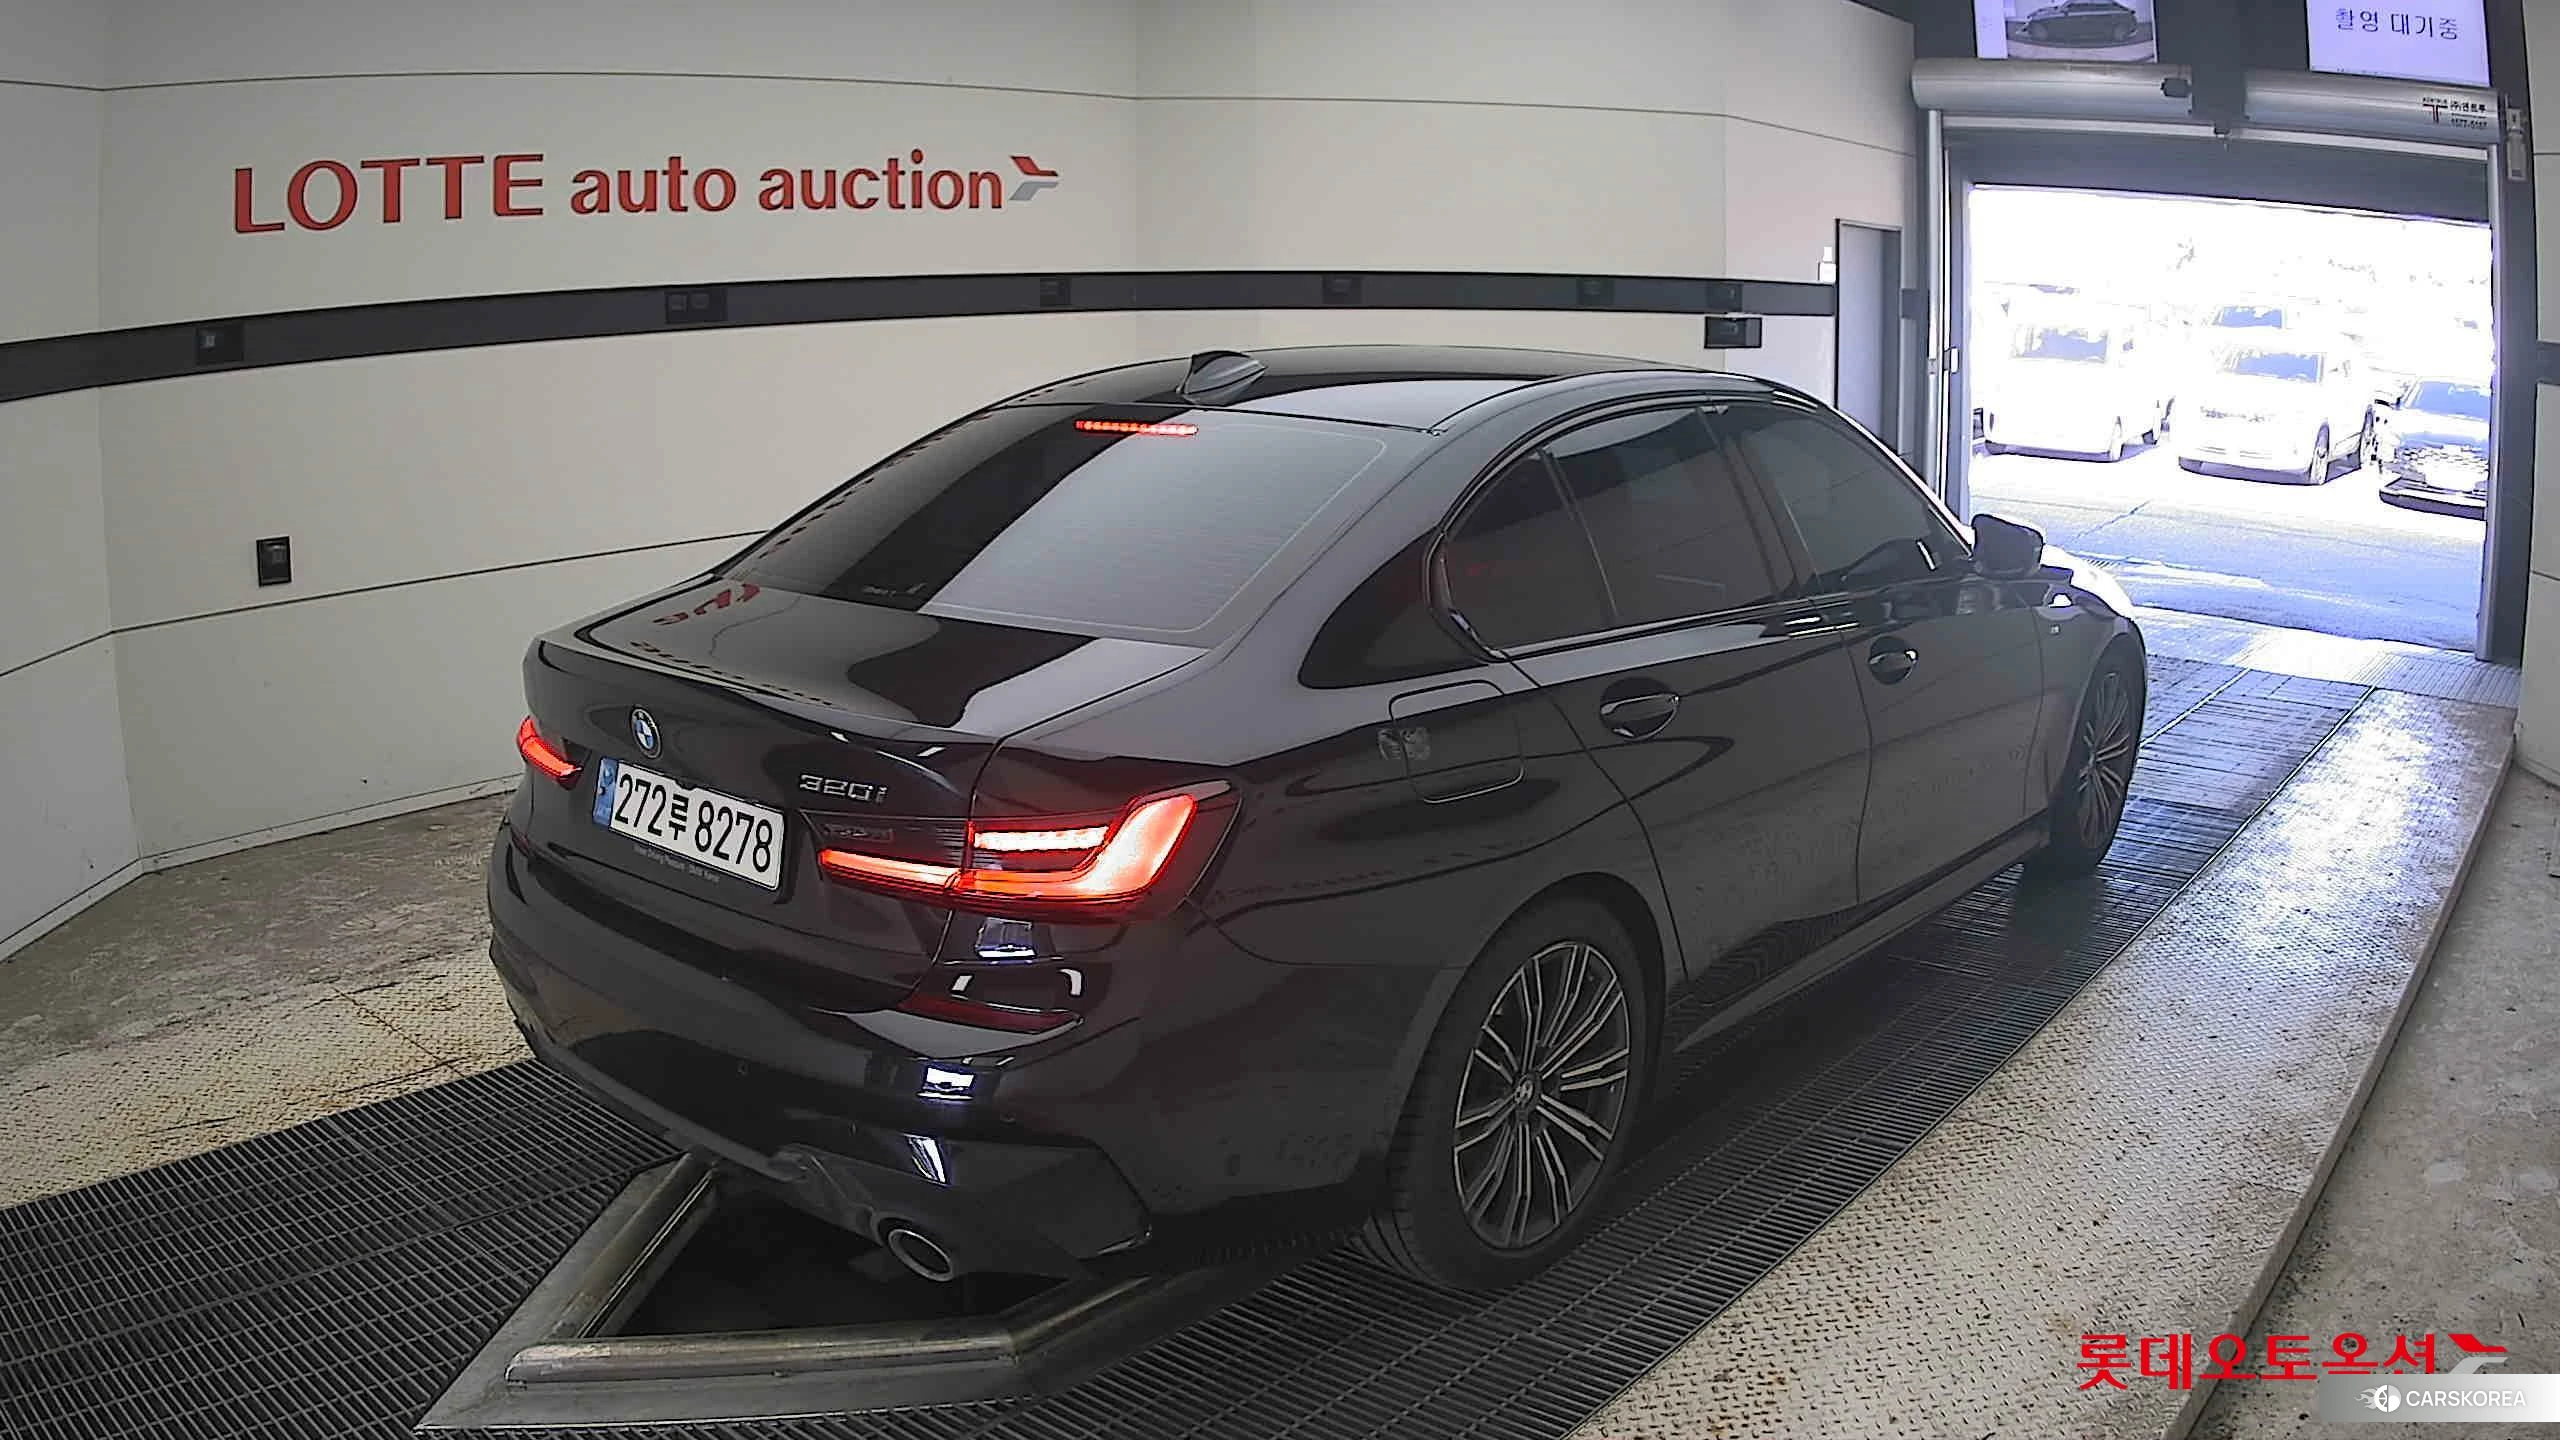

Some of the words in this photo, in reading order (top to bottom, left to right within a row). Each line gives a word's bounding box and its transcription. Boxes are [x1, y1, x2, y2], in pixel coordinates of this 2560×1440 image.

[2336, 8, 2379, 33] 촬영
[2390, 13, 2458, 40] 대기중
[234, 153, 545, 233] LOTTE
[570, 156, 737, 215] auto
[757, 148, 1004, 211] auction
[799, 774, 888, 803] 320i
